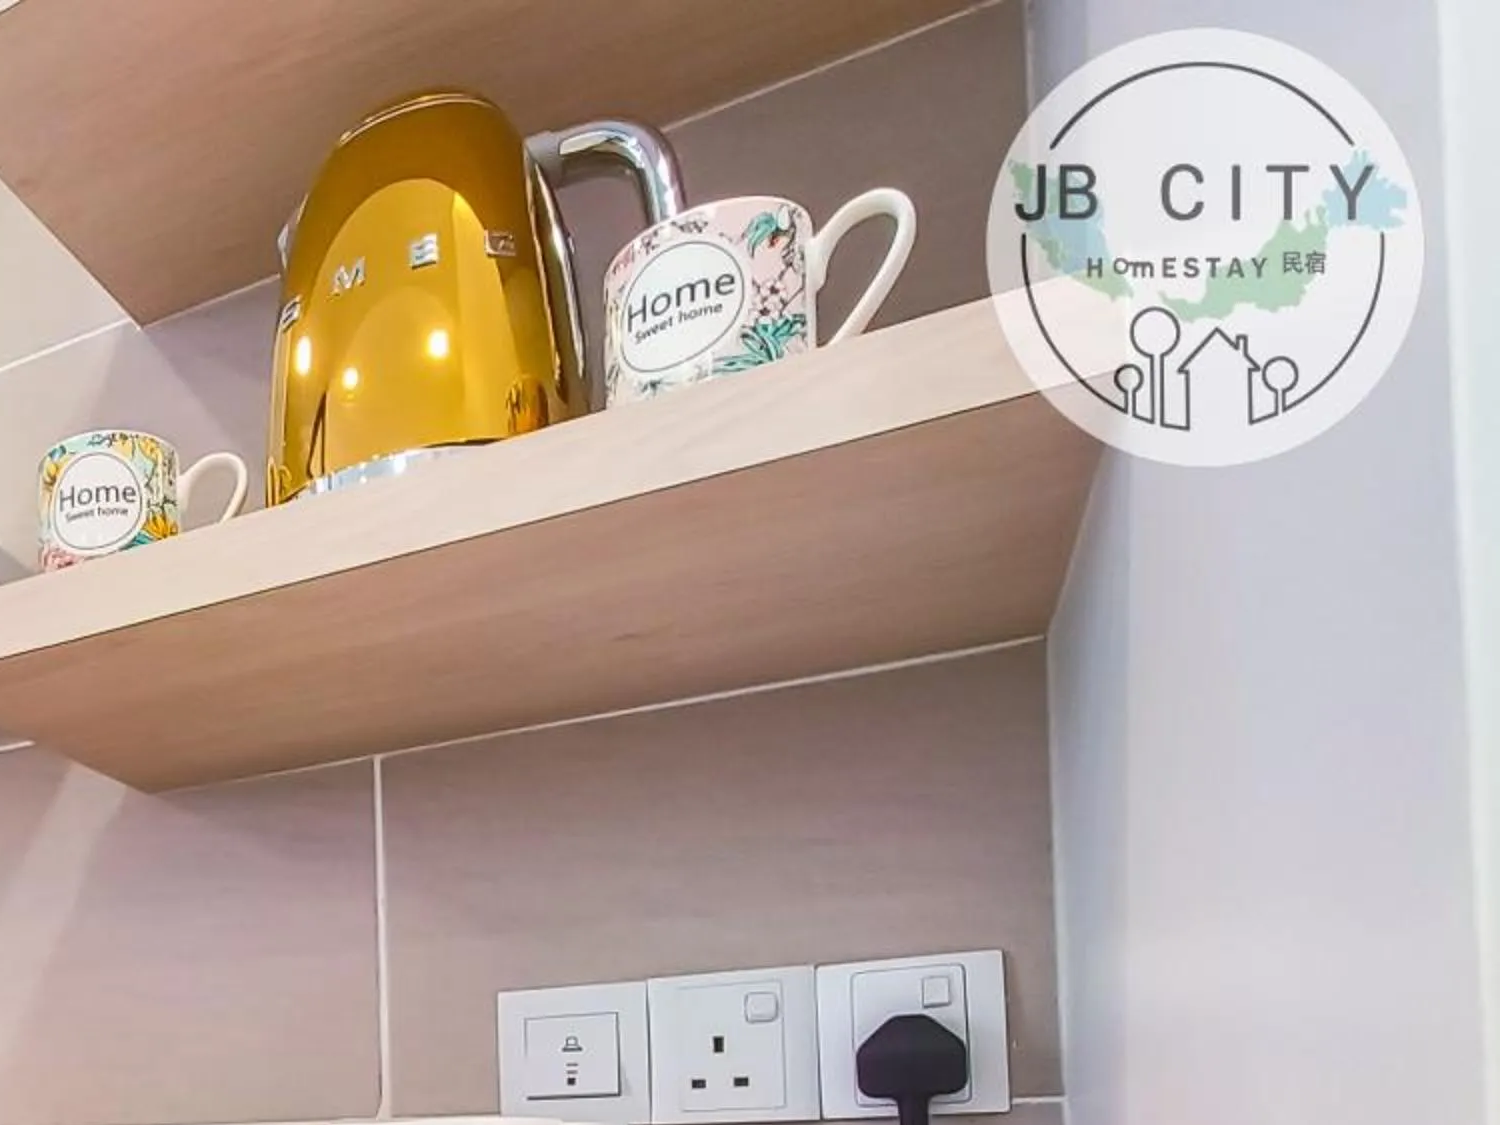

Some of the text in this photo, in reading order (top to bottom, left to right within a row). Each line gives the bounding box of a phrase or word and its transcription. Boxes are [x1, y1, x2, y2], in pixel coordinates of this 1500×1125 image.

[626, 273, 736, 333] Home
[678, 302, 724, 324] home
[59, 485, 137, 513] Home
